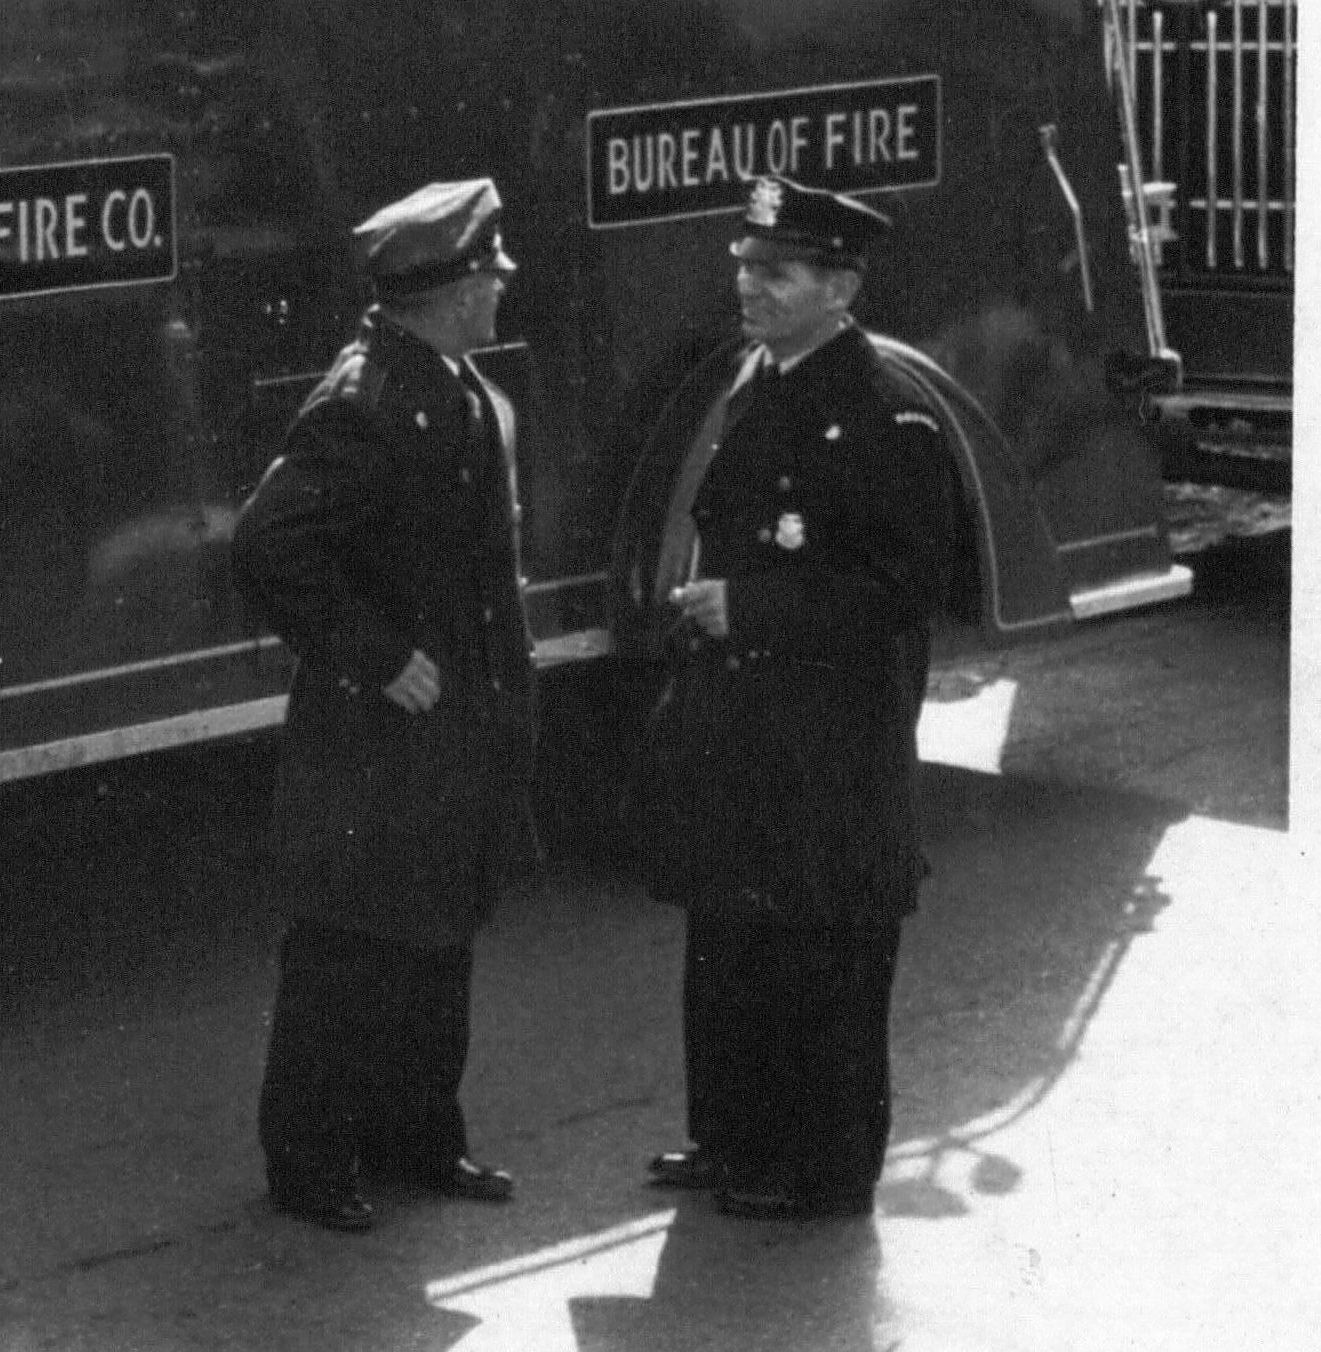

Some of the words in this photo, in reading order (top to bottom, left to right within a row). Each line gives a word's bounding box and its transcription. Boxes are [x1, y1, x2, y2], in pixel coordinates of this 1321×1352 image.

[608, 122, 755, 195] BUREAU
[767, 115, 810, 176] OF
[825, 103, 919, 169] FIRE
[102, 188, 163, 250] CO.
